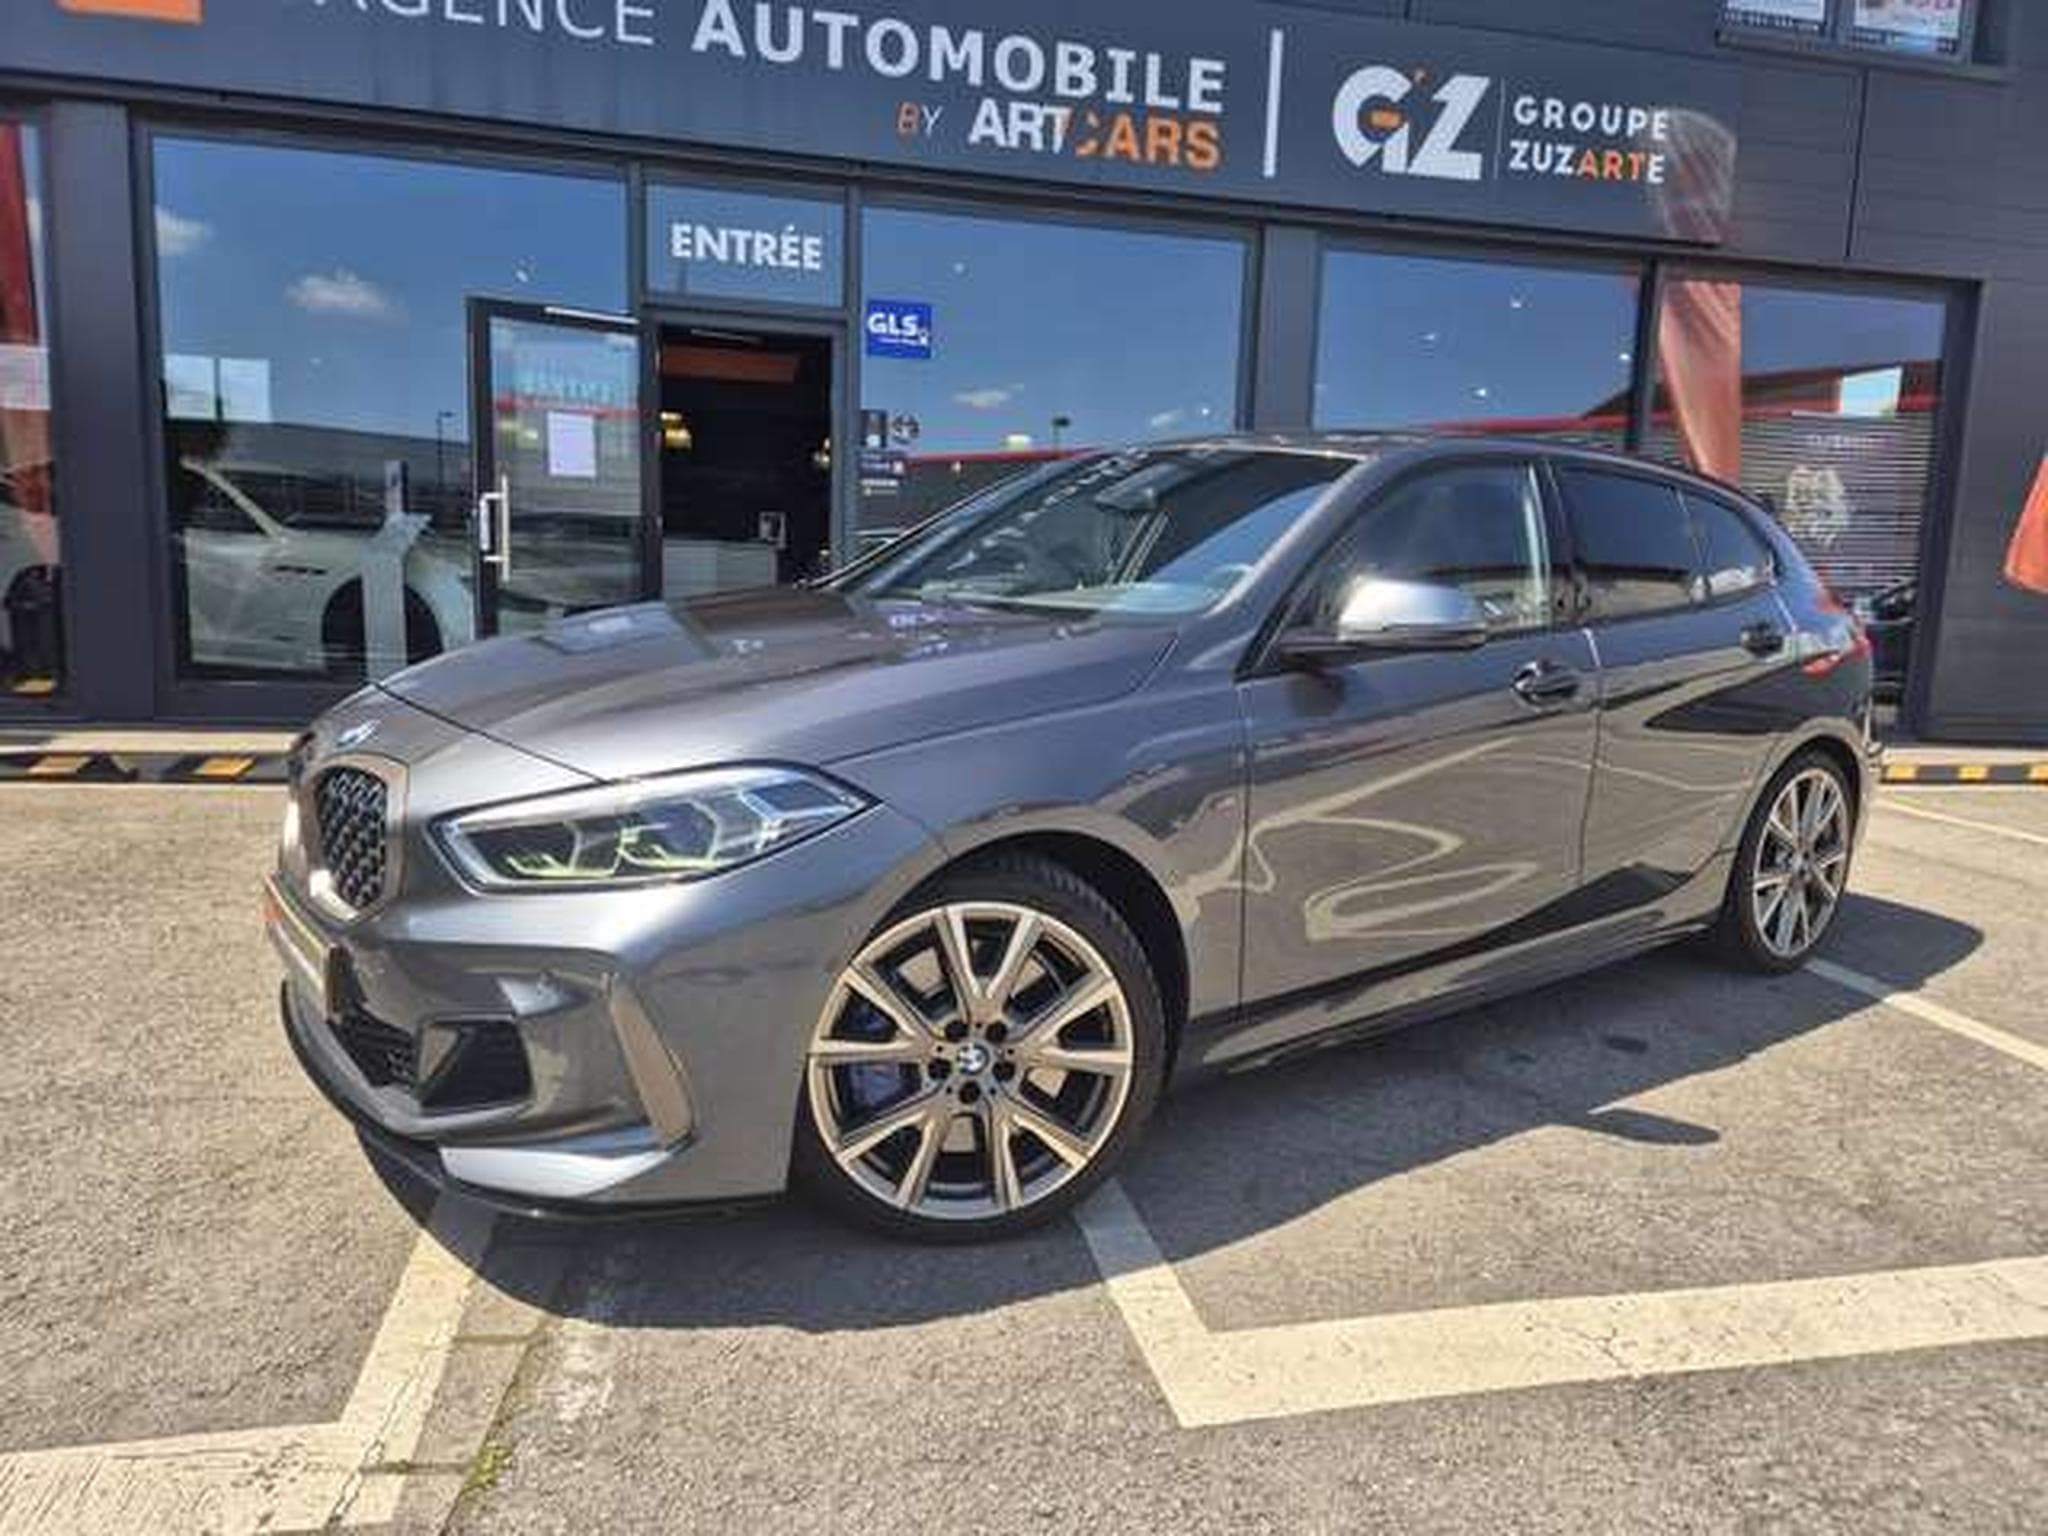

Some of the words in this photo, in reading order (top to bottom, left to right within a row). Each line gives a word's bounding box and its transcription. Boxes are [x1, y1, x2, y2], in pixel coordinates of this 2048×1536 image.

[691, 0, 1224, 113] AUTOMOBILE
[897, 102, 942, 137] BY
[1513, 94, 1669, 141] GROUPE
[1508, 139, 1666, 184] ZUZARTE
[671, 223, 822, 270] ENTRÉE
[868, 312, 918, 337] GLS
